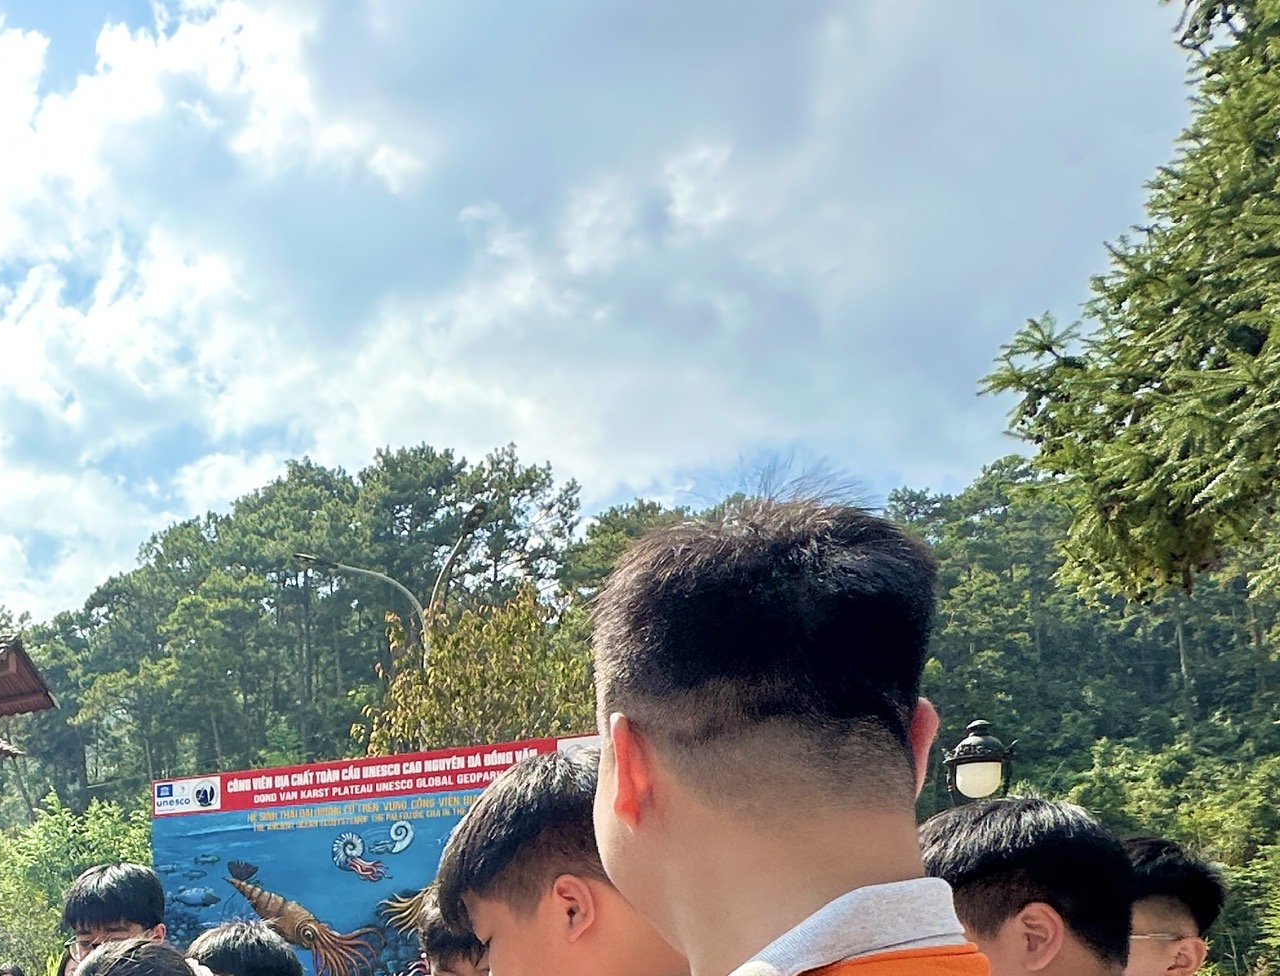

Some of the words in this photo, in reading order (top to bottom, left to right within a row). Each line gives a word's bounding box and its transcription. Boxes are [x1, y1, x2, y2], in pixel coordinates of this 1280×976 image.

[291, 769, 314, 787] CHẤT
[316, 769, 340, 784] TOÀN
[362, 763, 401, 779] UNESCO
[403, 760, 422, 774] CAO
[424, 755, 465, 773] NGUYÊN
[467, 752, 482, 768] ĐÁ
[156, 798, 191, 808] unesco
[254, 793, 277, 804] DONG
[280, 790, 298, 801] VAN
[300, 787, 329, 799] KARST
[332, 783, 373, 796] PLATEAU
[376, 779, 413, 792] UNESCO
[416, 775, 454, 789] GLOBAL
